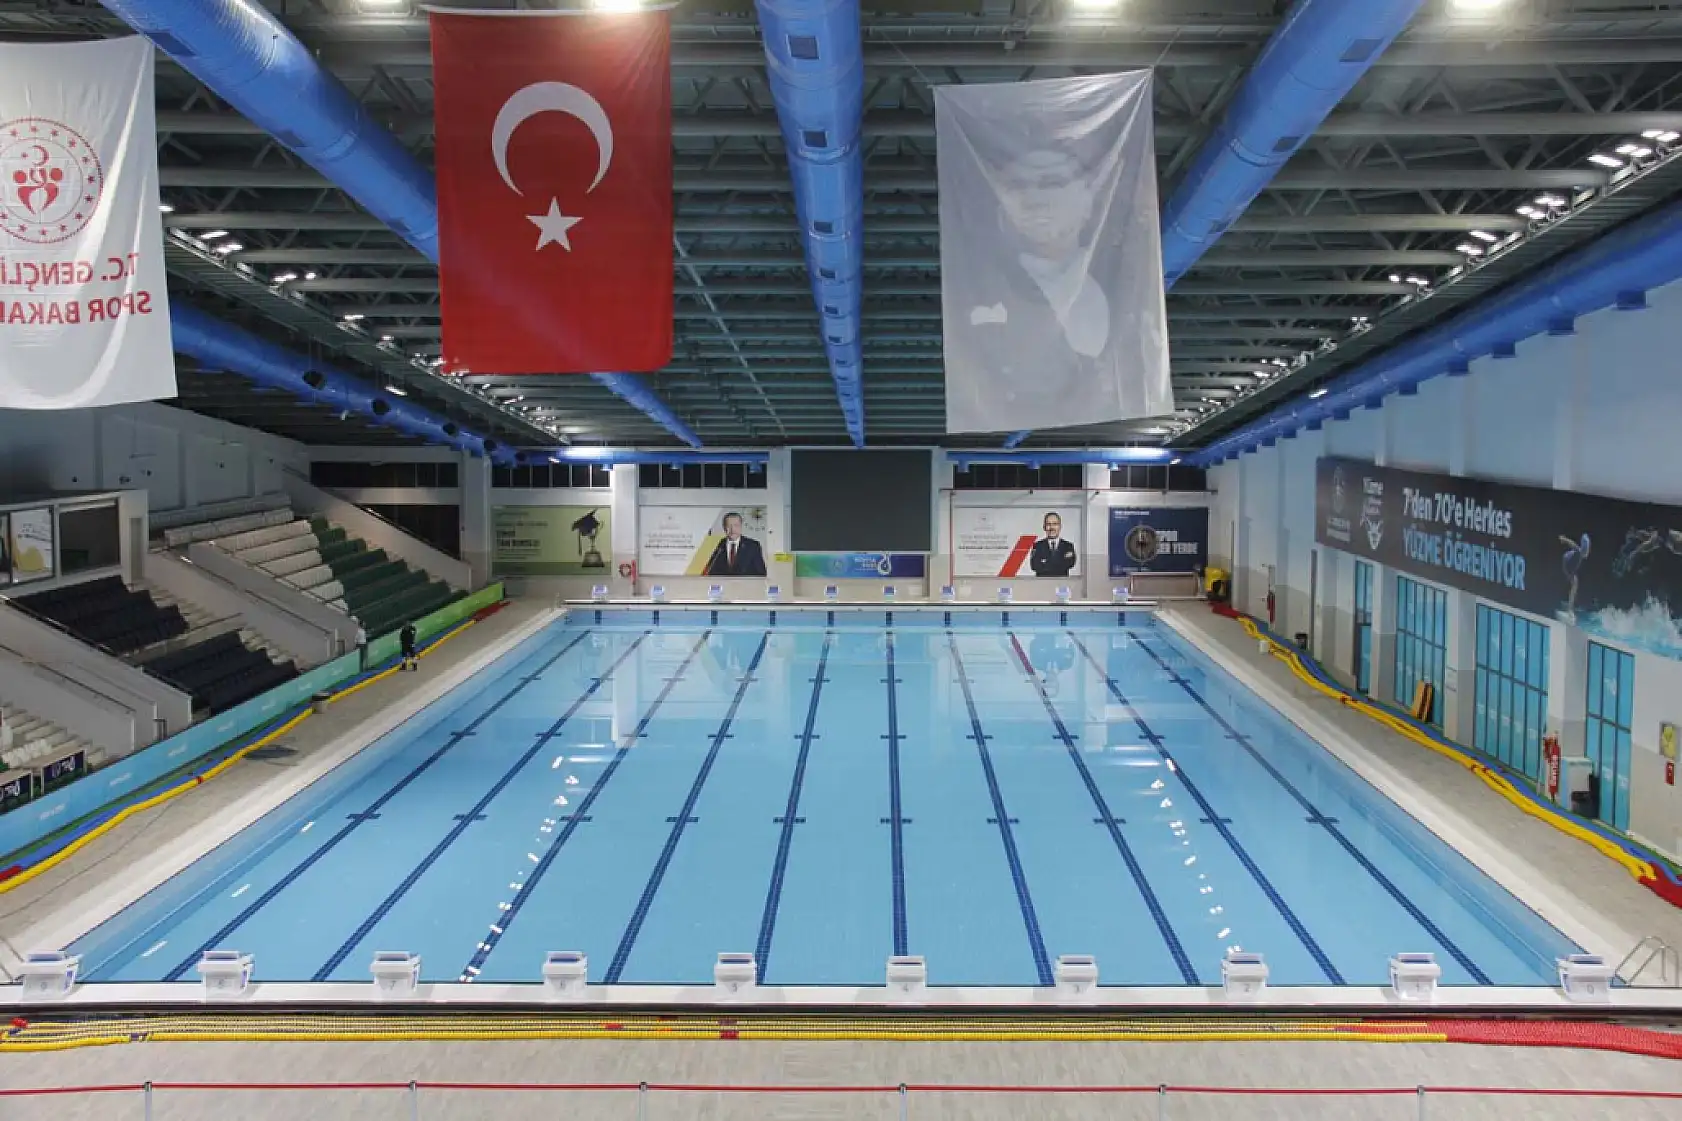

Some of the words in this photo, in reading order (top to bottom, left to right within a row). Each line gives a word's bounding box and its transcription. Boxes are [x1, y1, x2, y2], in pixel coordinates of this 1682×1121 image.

[1402, 486, 1432, 522] 7'den
[1464, 496, 1512, 538] Herkes
[1403, 523, 1442, 565] YÜZME
[1444, 531, 1526, 590] ÖĞRENİYOR
